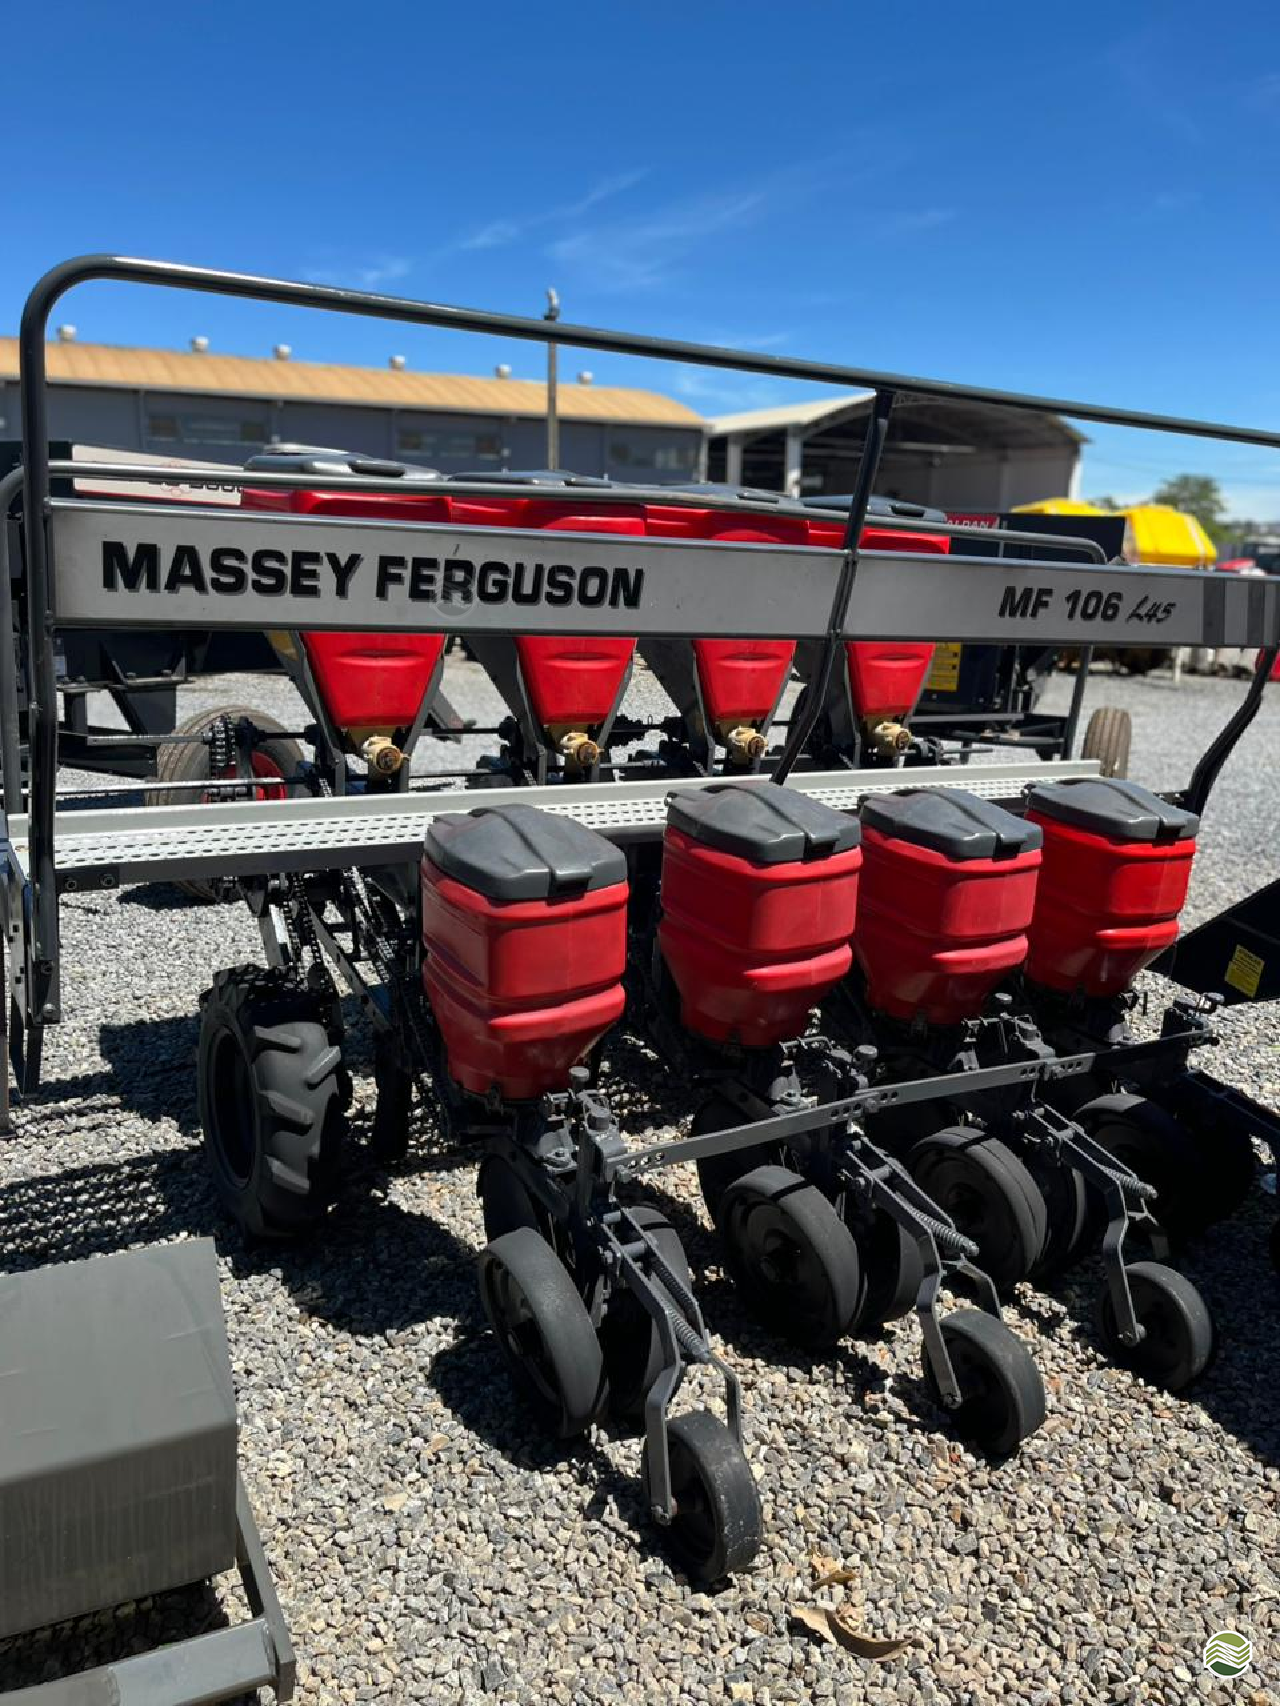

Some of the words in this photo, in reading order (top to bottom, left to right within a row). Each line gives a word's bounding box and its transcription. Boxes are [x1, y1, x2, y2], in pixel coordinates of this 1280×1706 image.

[102, 541, 363, 599] MASSEY
[376, 555, 645, 610] FERGUSON
[999, 586, 1053, 618] MF
[1065, 589, 1123, 621] 106
